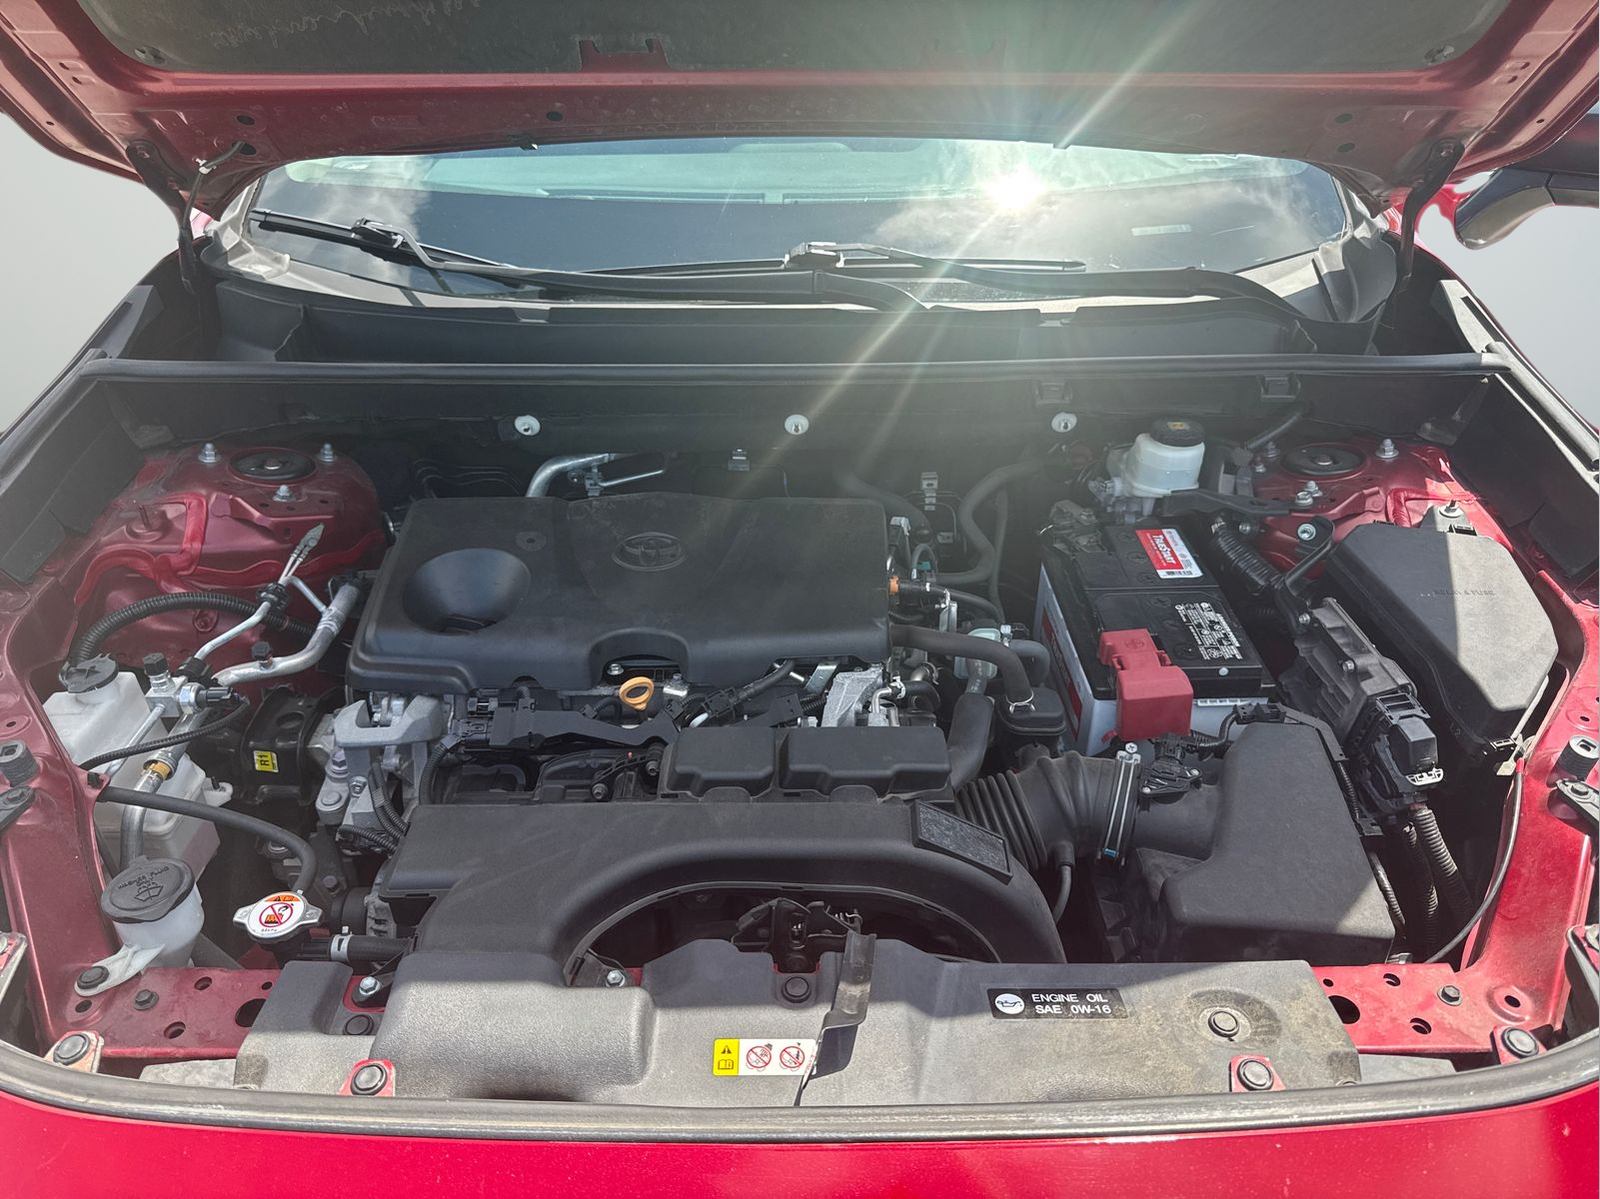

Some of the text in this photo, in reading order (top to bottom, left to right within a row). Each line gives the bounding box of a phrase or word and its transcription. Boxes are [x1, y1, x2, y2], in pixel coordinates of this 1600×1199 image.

[258, 754, 270, 766] R1
[1031, 993, 1108, 1003] ENGINE OIL
[1035, 1004, 1112, 1014] SAE 0W-16
